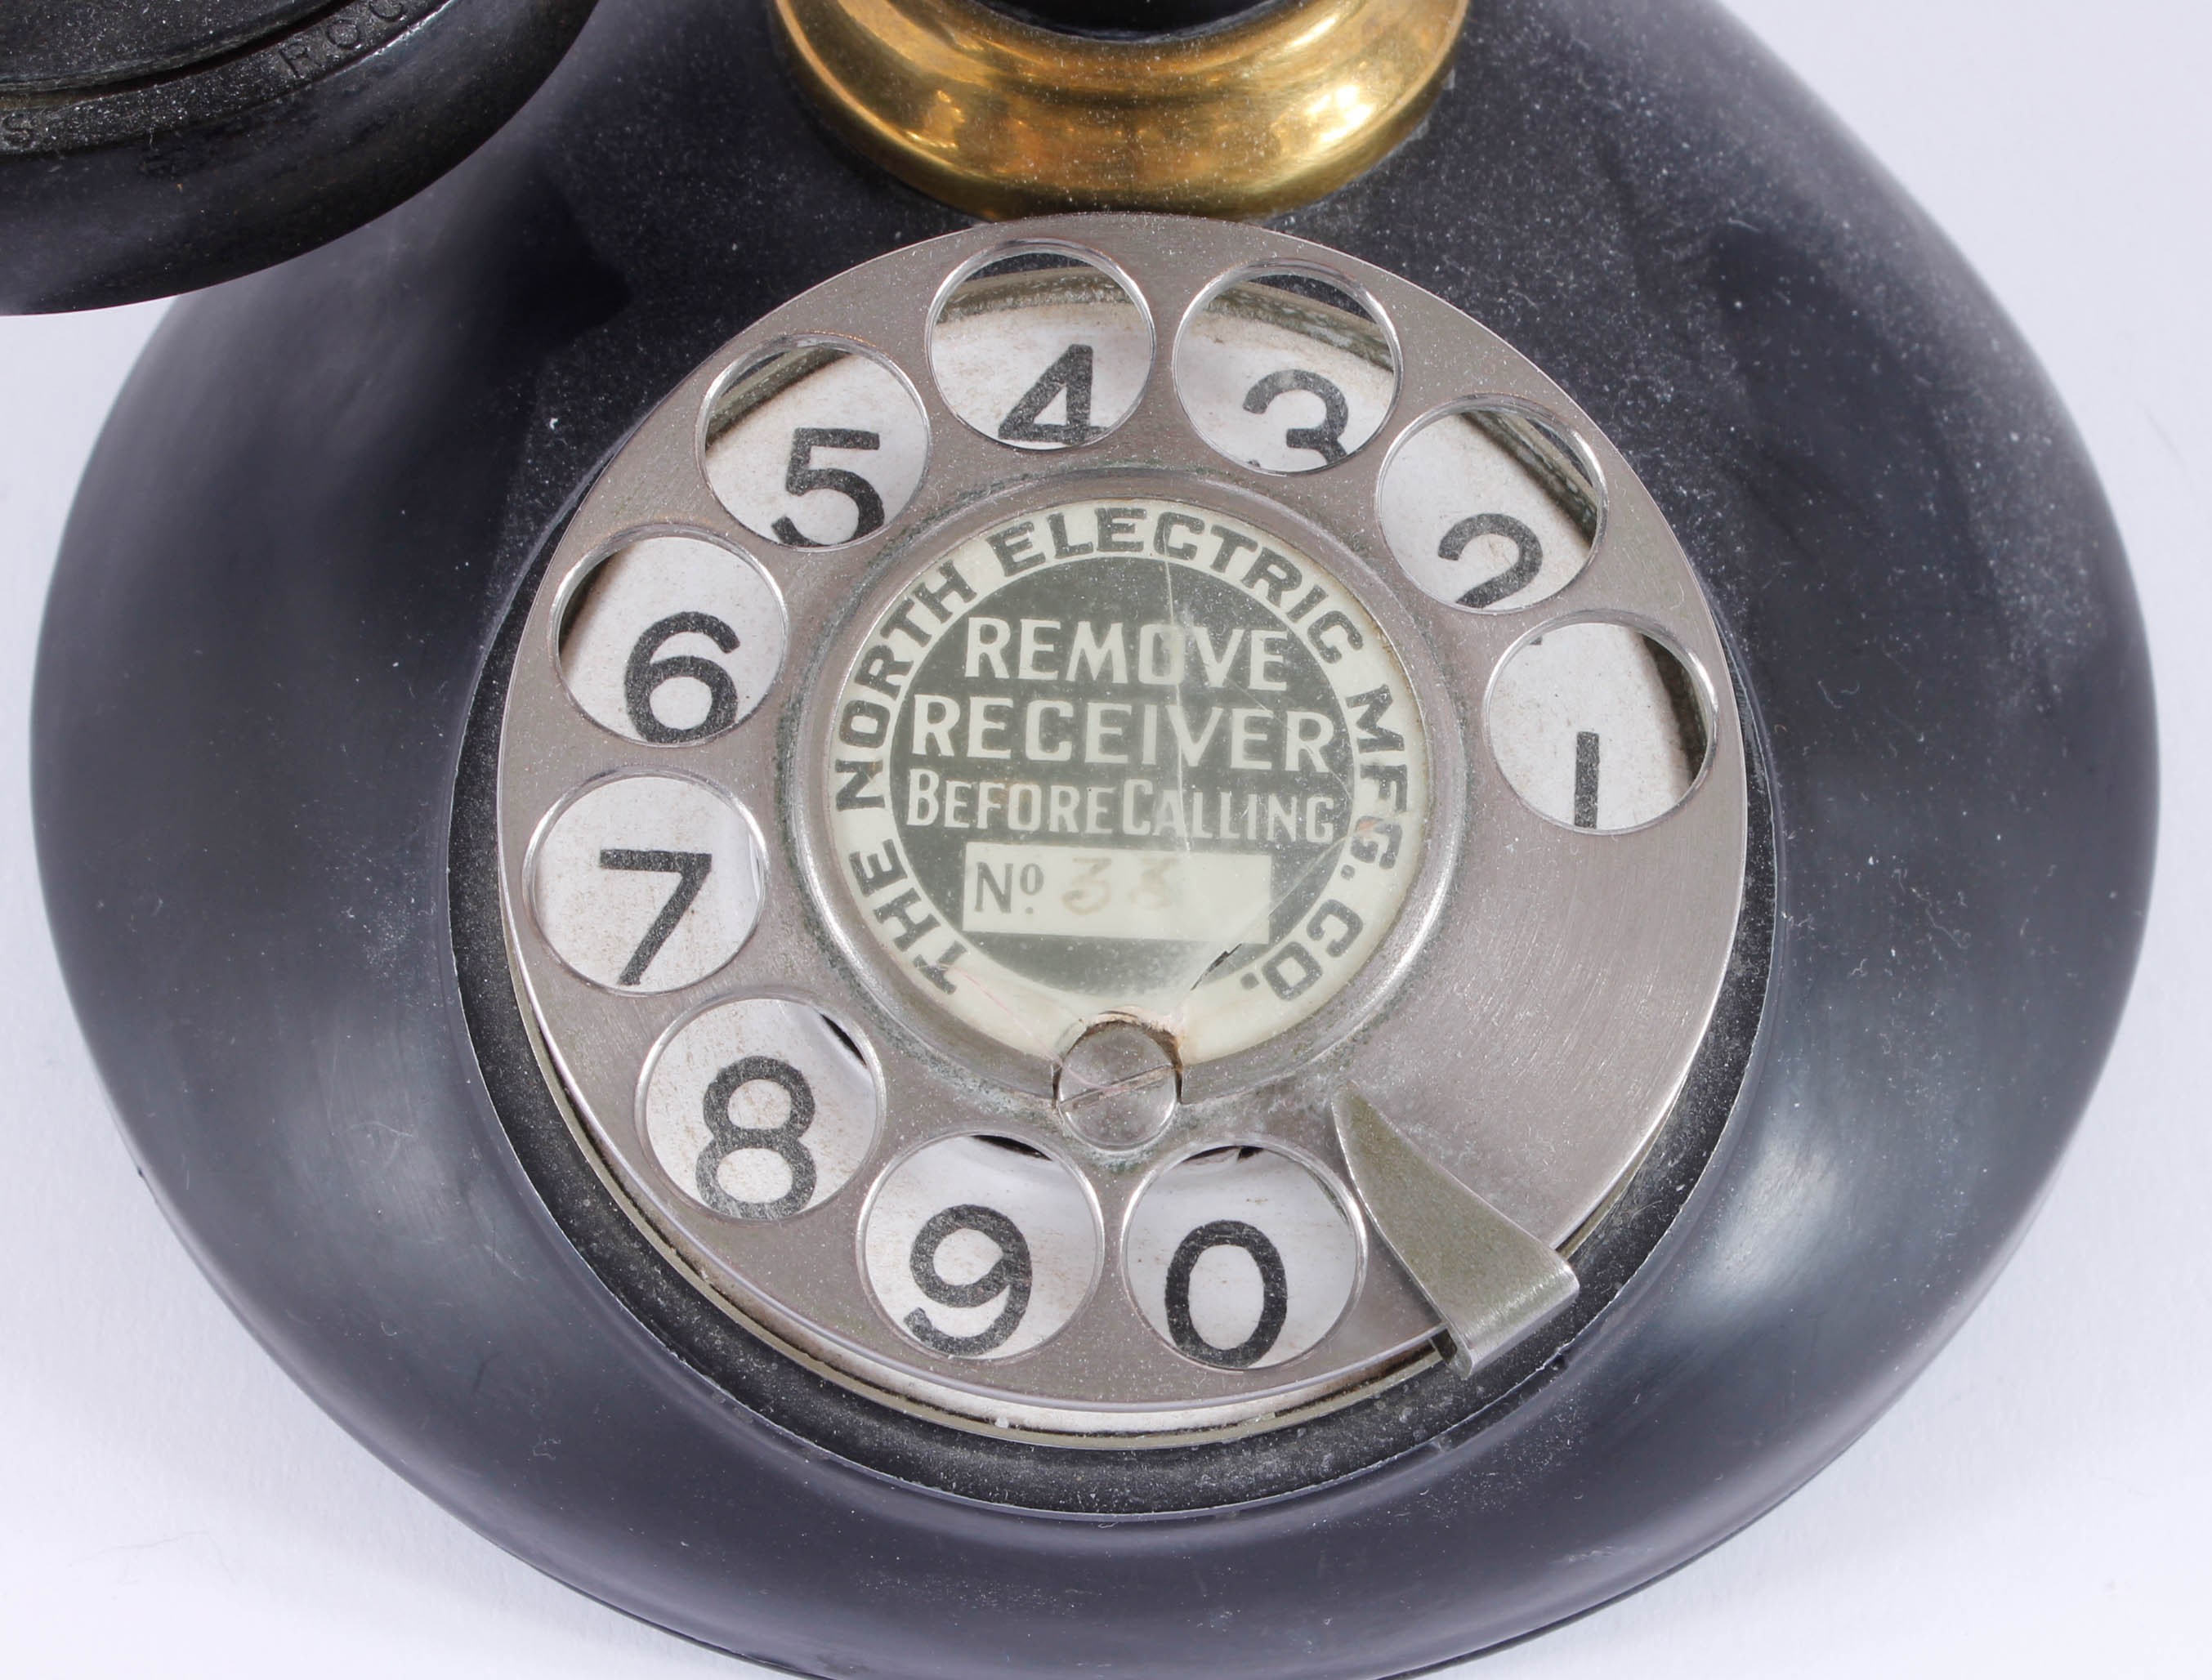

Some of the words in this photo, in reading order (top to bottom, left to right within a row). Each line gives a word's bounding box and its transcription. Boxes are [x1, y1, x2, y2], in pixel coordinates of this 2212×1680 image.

[998, 343, 1109, 445] 4
[1242, 369, 1349, 469] 3
[771, 427, 886, 547] 5
[987, 507, 1364, 665] ELECTRIC
[1437, 512, 1544, 610] 2
[625, 611, 741, 744] 6
[834, 561, 978, 813] NORTH
[964, 616, 1289, 691] REMOVE
[911, 694, 1334, 773] RECEIVER
[1574, 731, 1599, 829] 1
[599, 849, 713, 985] 7
[849, 838, 972, 996] THE
[1240, 912, 1365, 1003] CO.
[695, 1056, 816, 1219] 8
[904, 1204, 1033, 1358] 9
[1164, 1219, 1288, 1370] 0
